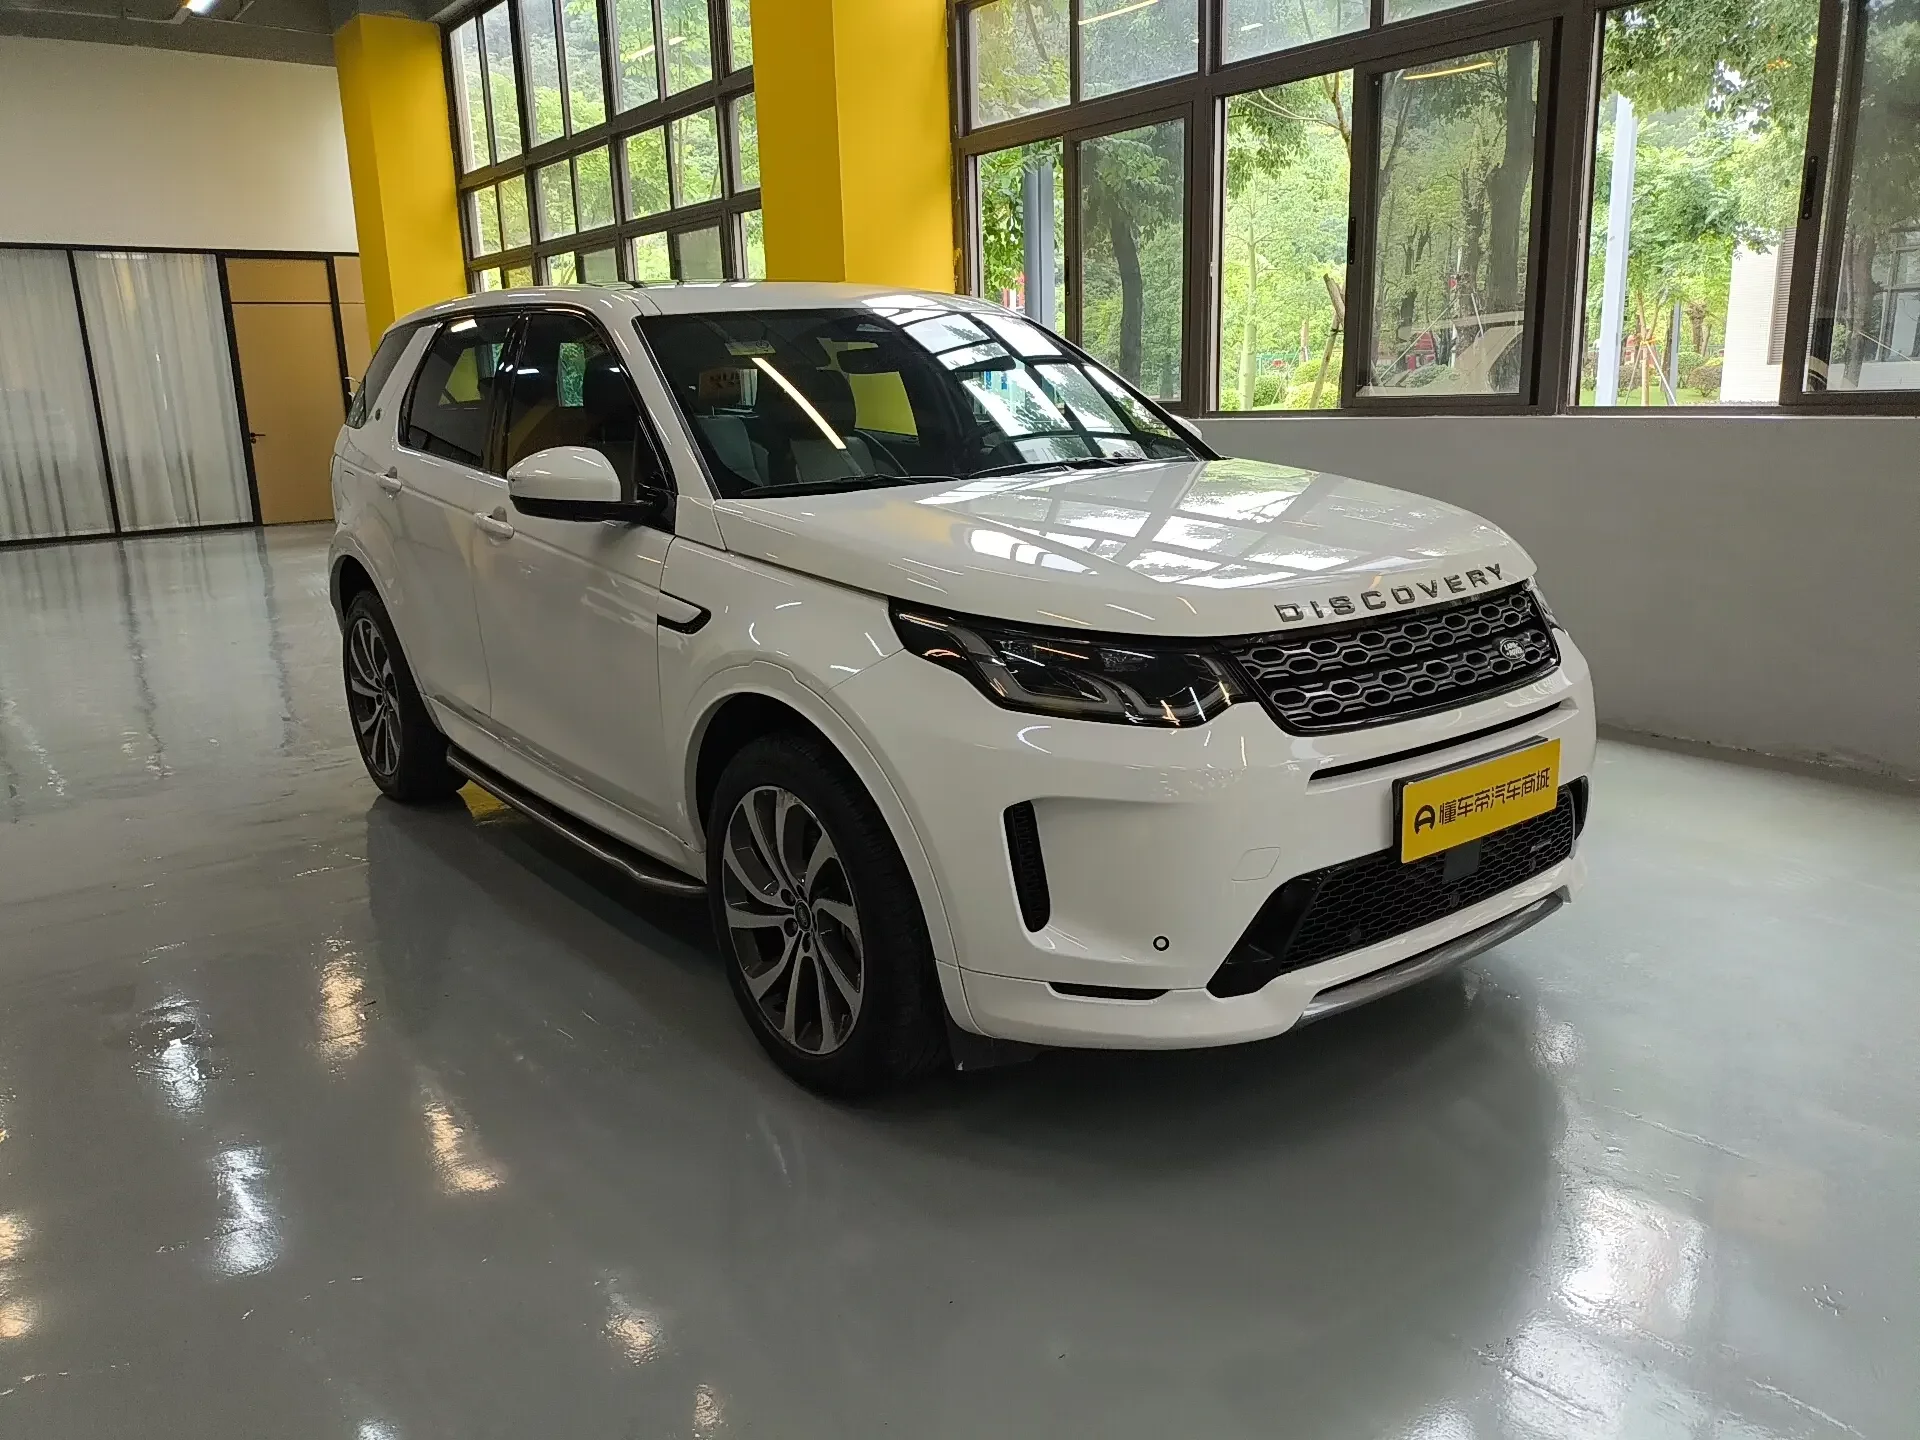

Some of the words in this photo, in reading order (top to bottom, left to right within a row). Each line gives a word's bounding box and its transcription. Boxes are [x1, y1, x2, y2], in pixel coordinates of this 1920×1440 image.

[1274, 563, 1503, 623] DISCOVERY
[1439, 767, 1551, 825] 懂车帝汽车商城
